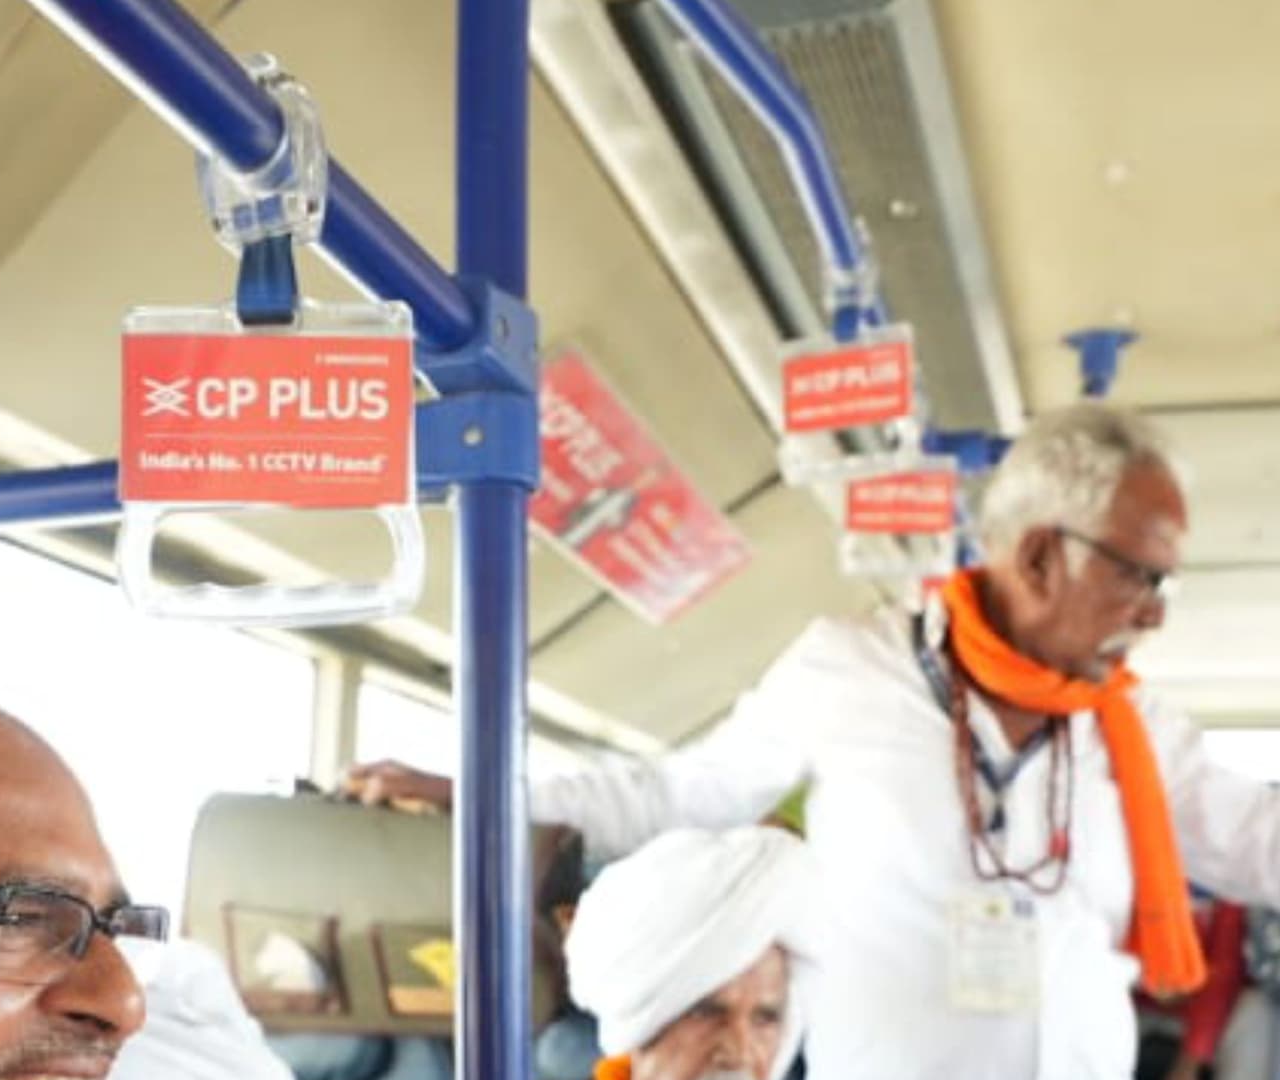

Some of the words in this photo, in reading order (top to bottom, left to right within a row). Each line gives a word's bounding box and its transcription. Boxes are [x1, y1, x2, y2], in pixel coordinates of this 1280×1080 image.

[196, 377, 258, 420] CP
[268, 377, 389, 421] PLUS
[139, 450, 205, 471] India's
[247, 452, 258, 471] 1
[262, 452, 317, 472] CCTV
